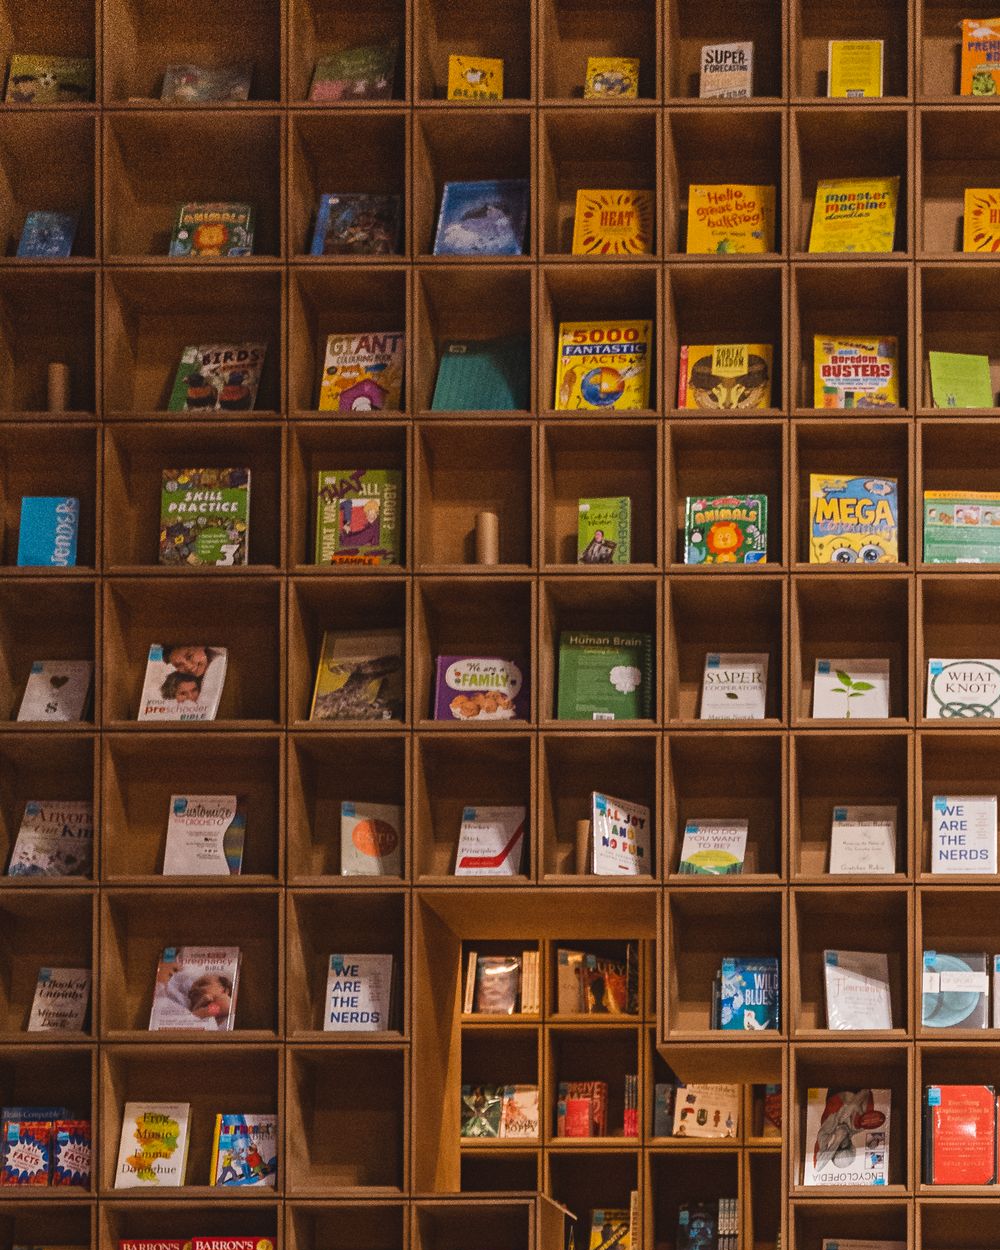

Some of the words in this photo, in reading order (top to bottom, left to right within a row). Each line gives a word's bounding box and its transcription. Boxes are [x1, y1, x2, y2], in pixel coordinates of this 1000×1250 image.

[704, 64, 748, 73] FORECASTING
[707, 190, 743, 205] Hello
[824, 190, 889, 203] monster
[824, 200, 887, 213] machine
[600, 211, 634, 227] HEAT
[572, 328, 639, 344] 5000
[329, 335, 402, 354] GIANT
[565, 343, 644, 356] FANTASTIC
[201, 349, 261, 367] BIRDS
[715, 348, 744, 359] ZODIAC
[582, 355, 628, 366] FACTS
[715, 357, 745, 367] WISDOM
[830, 355, 878, 366] Boredom
[822, 364, 891, 378] BUSTERS
[185, 490, 223, 502] SKILL
[358, 483, 380, 497] ALL
[168, 500, 239, 514] PRACTICE
[816, 499, 895, 526] MEGA
[695, 510, 757, 523] ANIMALS
[216, 543, 239, 566] 3
[570, 635, 610, 647] Human
[613, 636, 642, 648] Brain
[945, 682, 997, 694] KNOT?
[145, 704, 209, 715] preschooler
[939, 805, 964, 817] WE
[623, 814, 646, 830] JOY
[938, 849, 989, 861] NERDS
[332, 981, 362, 993] ARE
[332, 996, 359, 1008] THE
[330, 1011, 380, 1024] NERDS
[143, 1112, 170, 1126] Frog
[136, 1127, 172, 1141] Music
[121, 1163, 177, 1175] Donoghue
